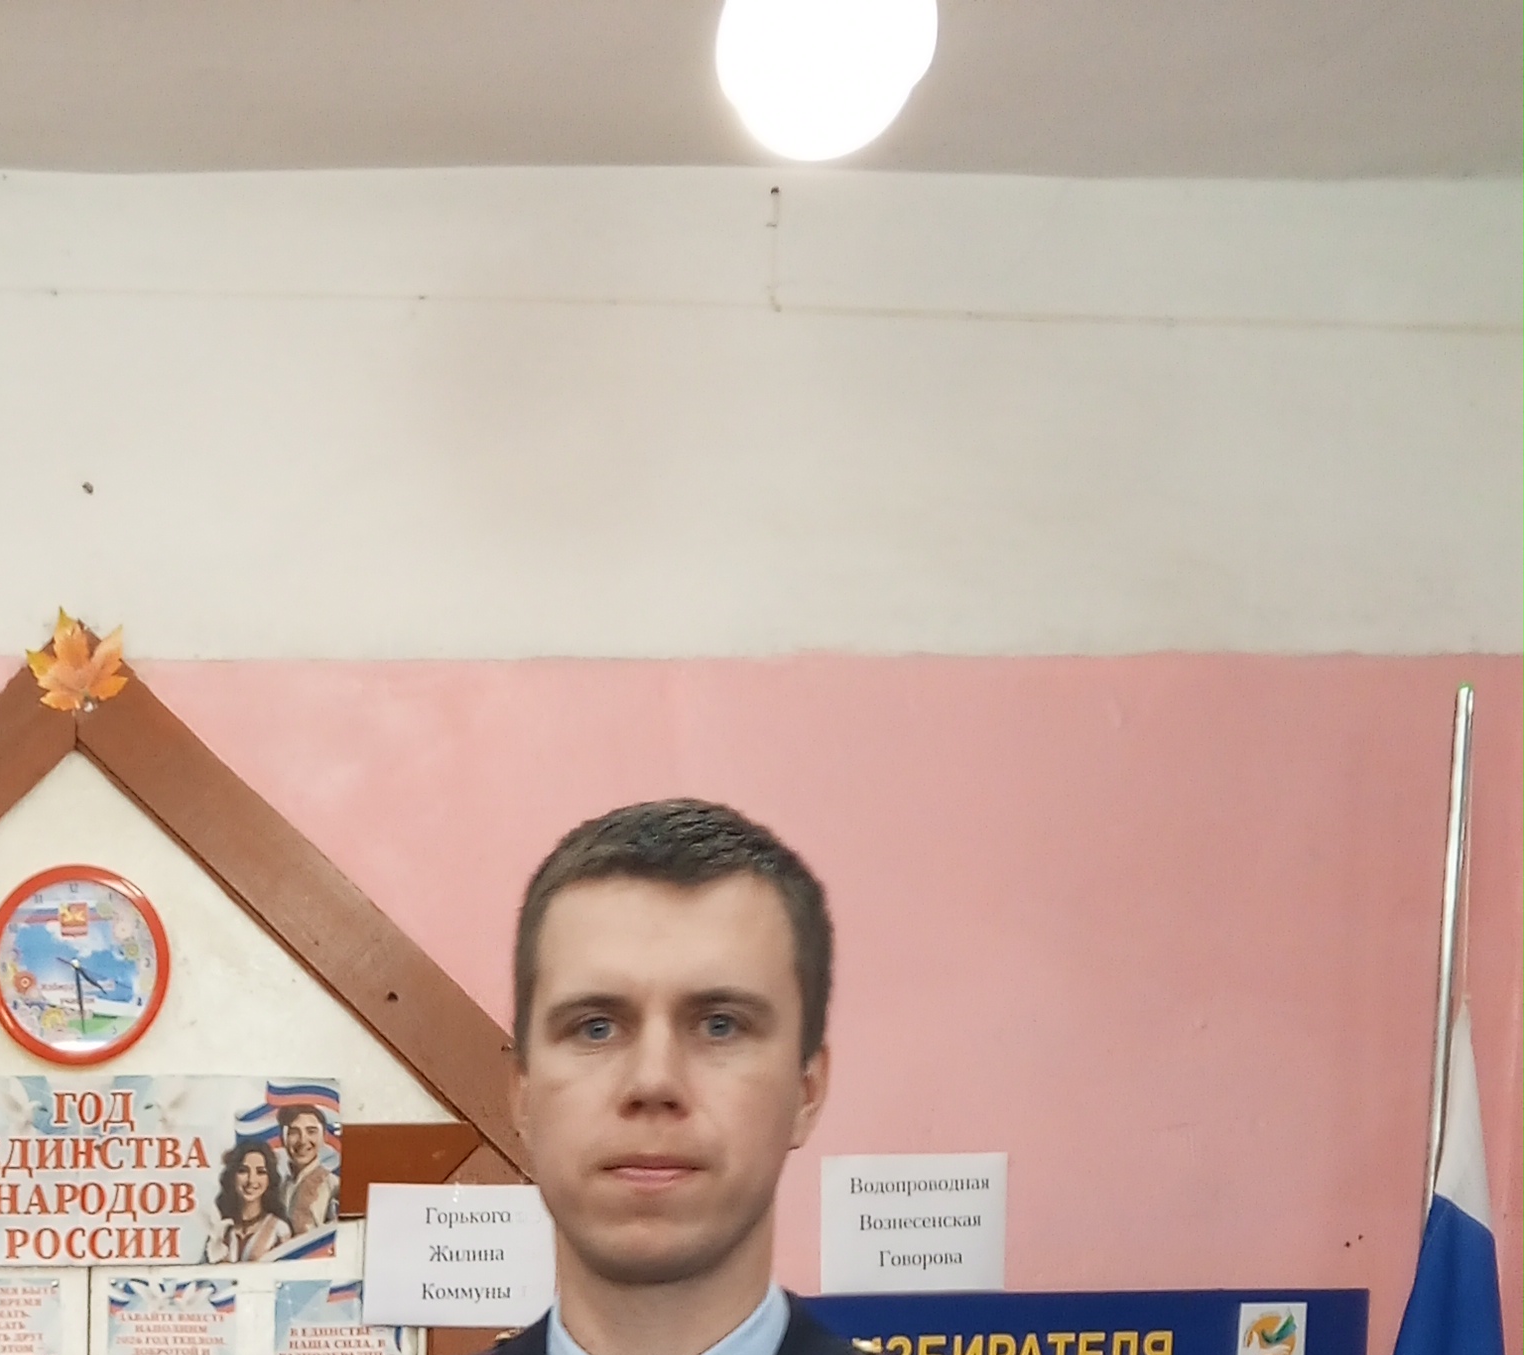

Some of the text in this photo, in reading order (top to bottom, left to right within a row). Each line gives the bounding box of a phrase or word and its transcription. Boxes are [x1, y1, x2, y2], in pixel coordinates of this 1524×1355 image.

[53, 1091, 134, 1131] ГОД
[850, 1177, 990, 1196] Водопроводная
[425, 1207, 511, 1228] Горького
[860, 1214, 982, 1231] Вознесенская
[5, 1227, 181, 1259] РОССИИ
[429, 1245, 505, 1262] Жилина
[879, 1250, 964, 1270] Говорова
[422, 1283, 511, 1303] Коммуны
